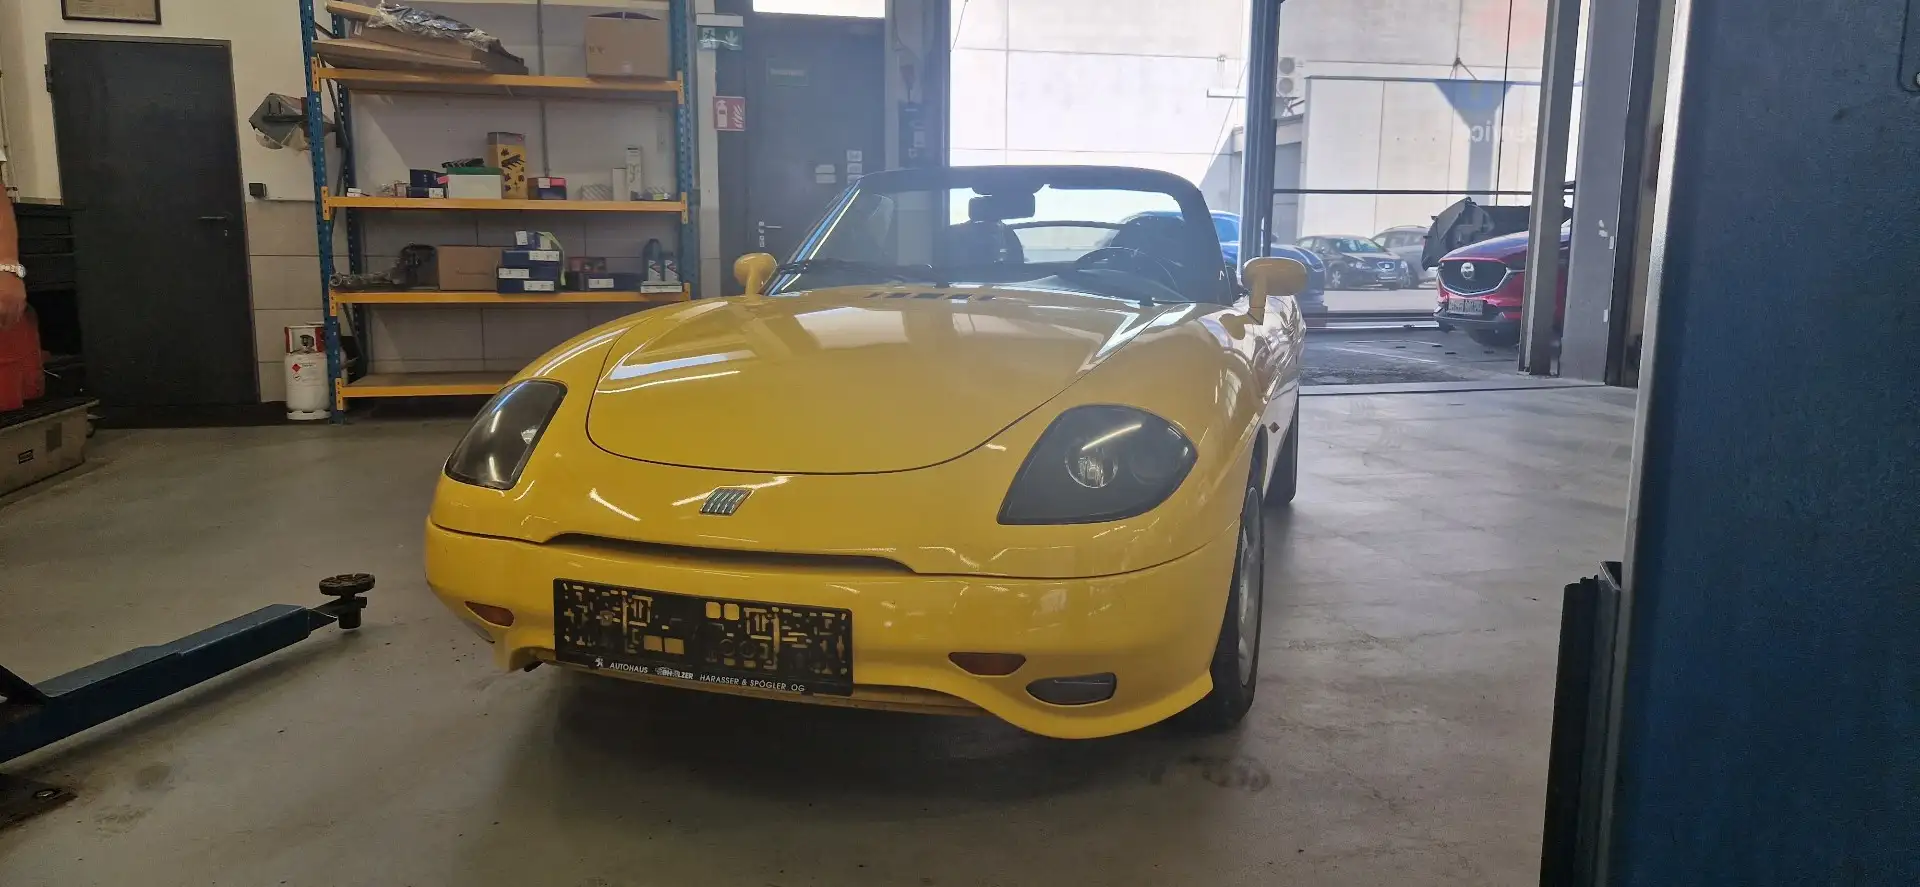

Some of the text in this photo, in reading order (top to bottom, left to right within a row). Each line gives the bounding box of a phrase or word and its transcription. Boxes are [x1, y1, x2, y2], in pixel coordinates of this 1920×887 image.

[609, 662, 649, 674] AUTOHAUS
[699, 673, 740, 685] HARASSER
[741, 678, 748, 686] &
[790, 683, 806, 692] OG
